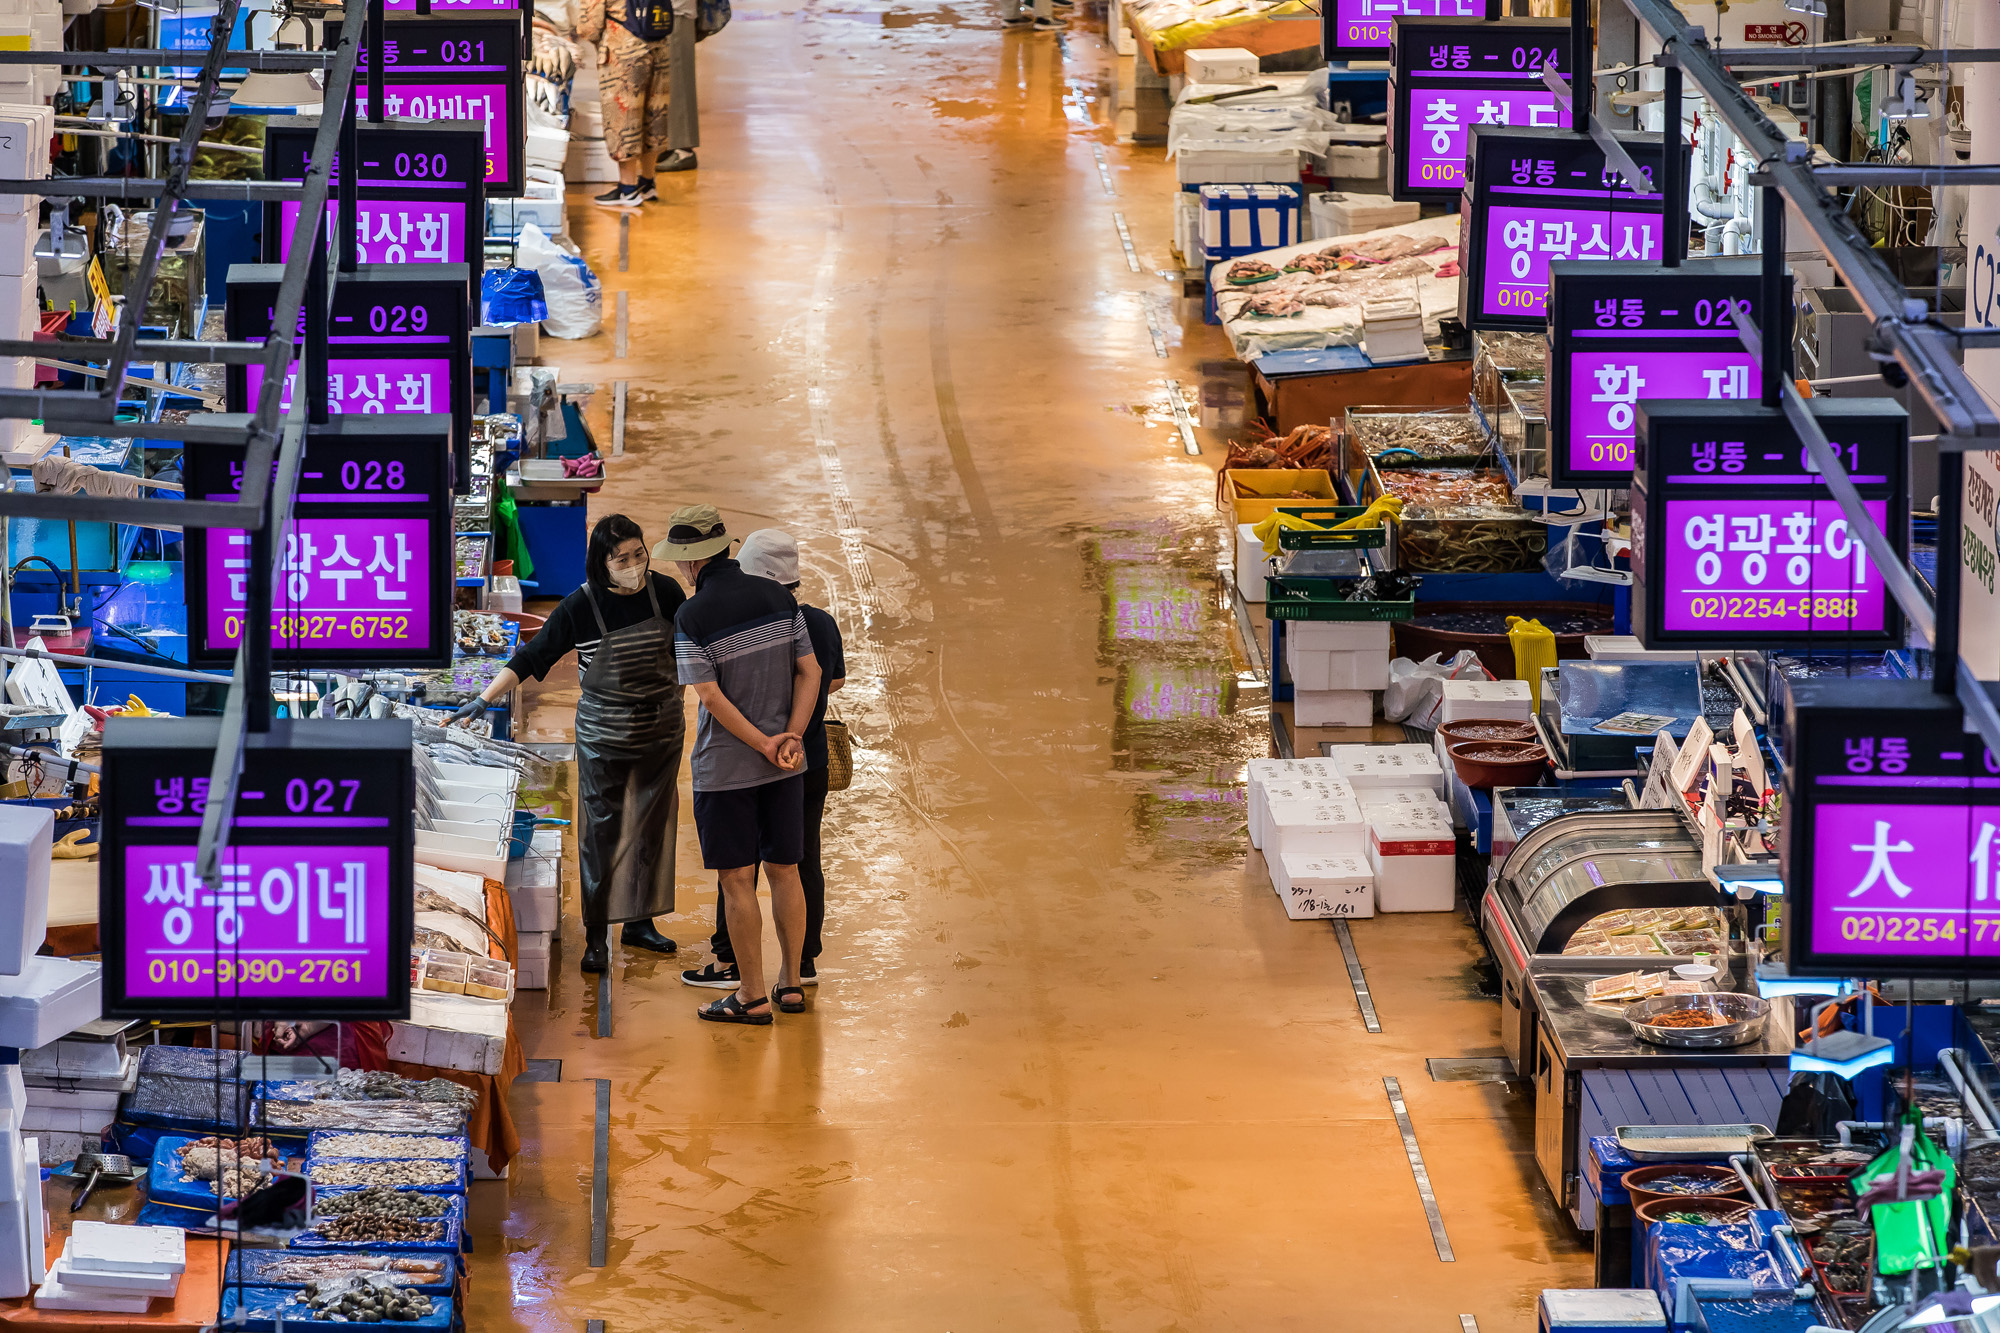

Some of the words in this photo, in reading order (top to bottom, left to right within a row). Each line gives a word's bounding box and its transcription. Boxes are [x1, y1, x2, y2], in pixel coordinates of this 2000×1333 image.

[441, 40, 484, 63] 031
[1430, 45, 1471, 69] 냉동
[395, 152, 447, 178] 030
[1511, 159, 1557, 186] 냉동
[370, 305, 428, 333] 029
[1594, 299, 1646, 327] 냉동
[1691, 441, 1747, 473] 냉동
[341, 460, 405, 490] 028
[1968, 465, 1994, 528] 간장게장
[1684, 512, 1867, 586] 영광홍어
[1963, 524, 1995, 595] 간장새우장
[1690, 596, 1859, 620] 02)2254-8888
[224, 615, 409, 639] 0-8927-6752
[1845, 737, 1911, 774] 냉동
[154, 777, 211, 814] 냉동
[285, 778, 361, 812] 027
[142, 861, 367, 945] 쌍둥이네
[148, 958, 363, 984] 010-9090-2761
